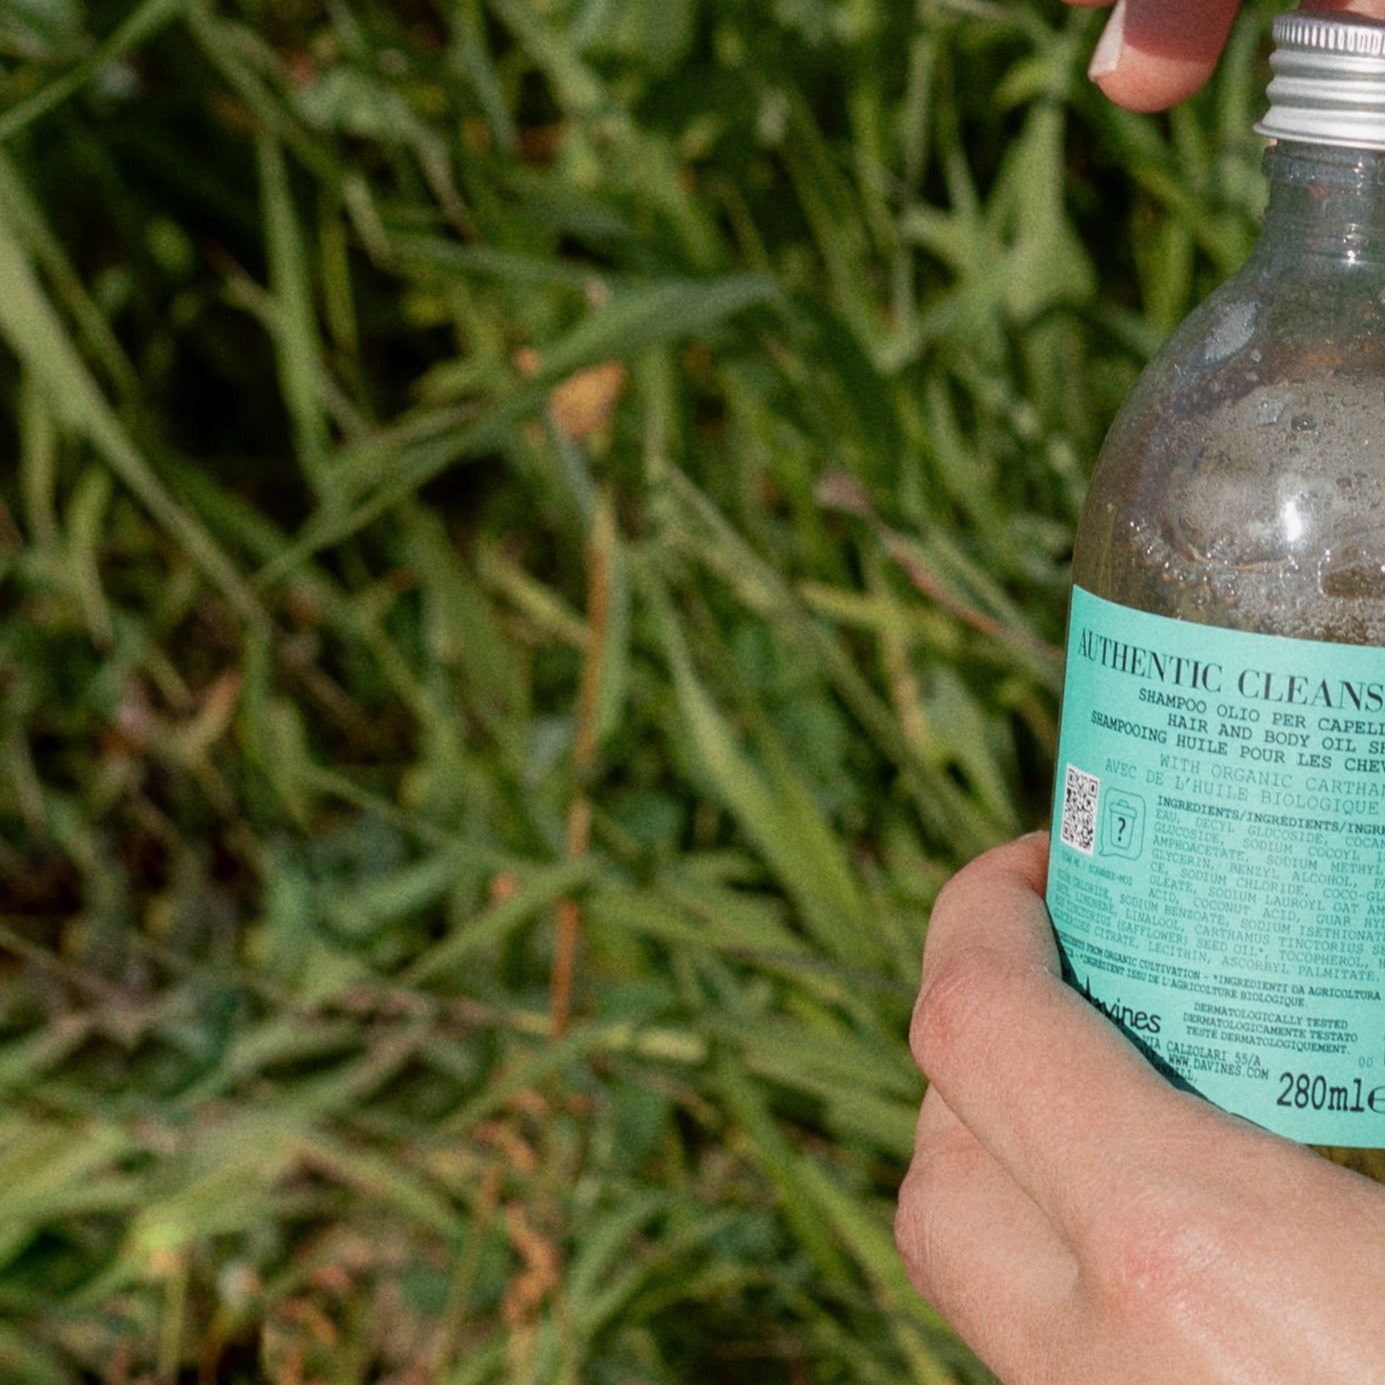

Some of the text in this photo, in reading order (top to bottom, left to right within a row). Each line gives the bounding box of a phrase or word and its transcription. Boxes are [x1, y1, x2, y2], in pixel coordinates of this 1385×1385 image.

[1078, 628, 1222, 693] AUTHENTIC
[1139, 688, 1207, 714] SHAMPOO
[1217, 704, 1260, 723] OLIO
[1272, 711, 1306, 730] PER
[1091, 710, 1167, 744] SHAMPOOING
[1176, 735, 1228, 756] HUILE
[1240, 747, 1286, 764] POUR
[1298, 754, 1332, 769] LES
[1168, 714, 1208, 733] HAIR
[1219, 722, 1253, 741] AND
[1264, 730, 1311, 748] BODY
[1322, 737, 1356, 753] OIL
[1105, 758, 1137, 779] AVEC
[1146, 770, 1165, 786] DE
[1175, 775, 1248, 802] L'HUILE
[1261, 789, 1380, 817] BIOLOGIQUE
[1160, 753, 1200, 775] WITH
[1211, 761, 1292, 788] ORGANIC
[1154, 822, 1225, 846] GLUCOSIDE,
[1243, 838, 1293, 855] SODIUM
[1307, 846, 1360, 862] COCOYL
[1155, 808, 1181, 824] EAU,
[1196, 817, 1235, 833] DECYL
[1247, 826, 1328, 846] GLUCOSIDE,
[1152, 849, 1216, 870] GLYCERIN,
[1229, 864, 1280, 880] BENZYL
[1292, 871, 1357, 890] ALCOHOL,
[1153, 835, 1249, 863] AMPHOACETATE,
[1267, 854, 1318, 871] SODIUM
[1331, 862, 1383, 877] METHYL
[1149, 875, 1197, 895] OLEATE,
[1208, 886, 1257, 903] SODIUM
[1264, 894, 1325, 911] LAUROYL
[1333, 902, 1360, 914] OAT
[1180, 868, 1227, 886] SODIUM
[1237, 877, 1309, 897] CHLORIDE,
[1119, 894, 1159, 912] SODIUM
[1241, 918, 1292, 935] SODIUM
[1193, 898, 1249, 915] COCONUT
[1316, 914, 1351, 927] GUAR
[1195, 922, 1270, 945] CARTHAMUS
[1279, 936, 1364, 955] TINCTORIUS
[1196, 937, 1228, 953] SEED
[1139, 958, 1201, 981] CULTIVATION
[1291, 984, 1306, 996] DA
[1308, 985, 1382, 1002] AGRICOLTURA
[1222, 955, 1290, 975] ASCORBYL
[1082, 975, 1162, 1033] vines
[1195, 1001, 1349, 1030] DERMATOLOGICALLY TESTED
[1182, 1012, 1358, 1043] DERMATOLOGICAMENTE TESTATO
[1166, 1040, 1227, 1063] CALZOLARI
[1234, 1052, 1261, 1067] 55/A
[1168, 1053, 1269, 1081] WWW.DAVINES.COM
[1277, 1071, 1364, 1113] 280ml
